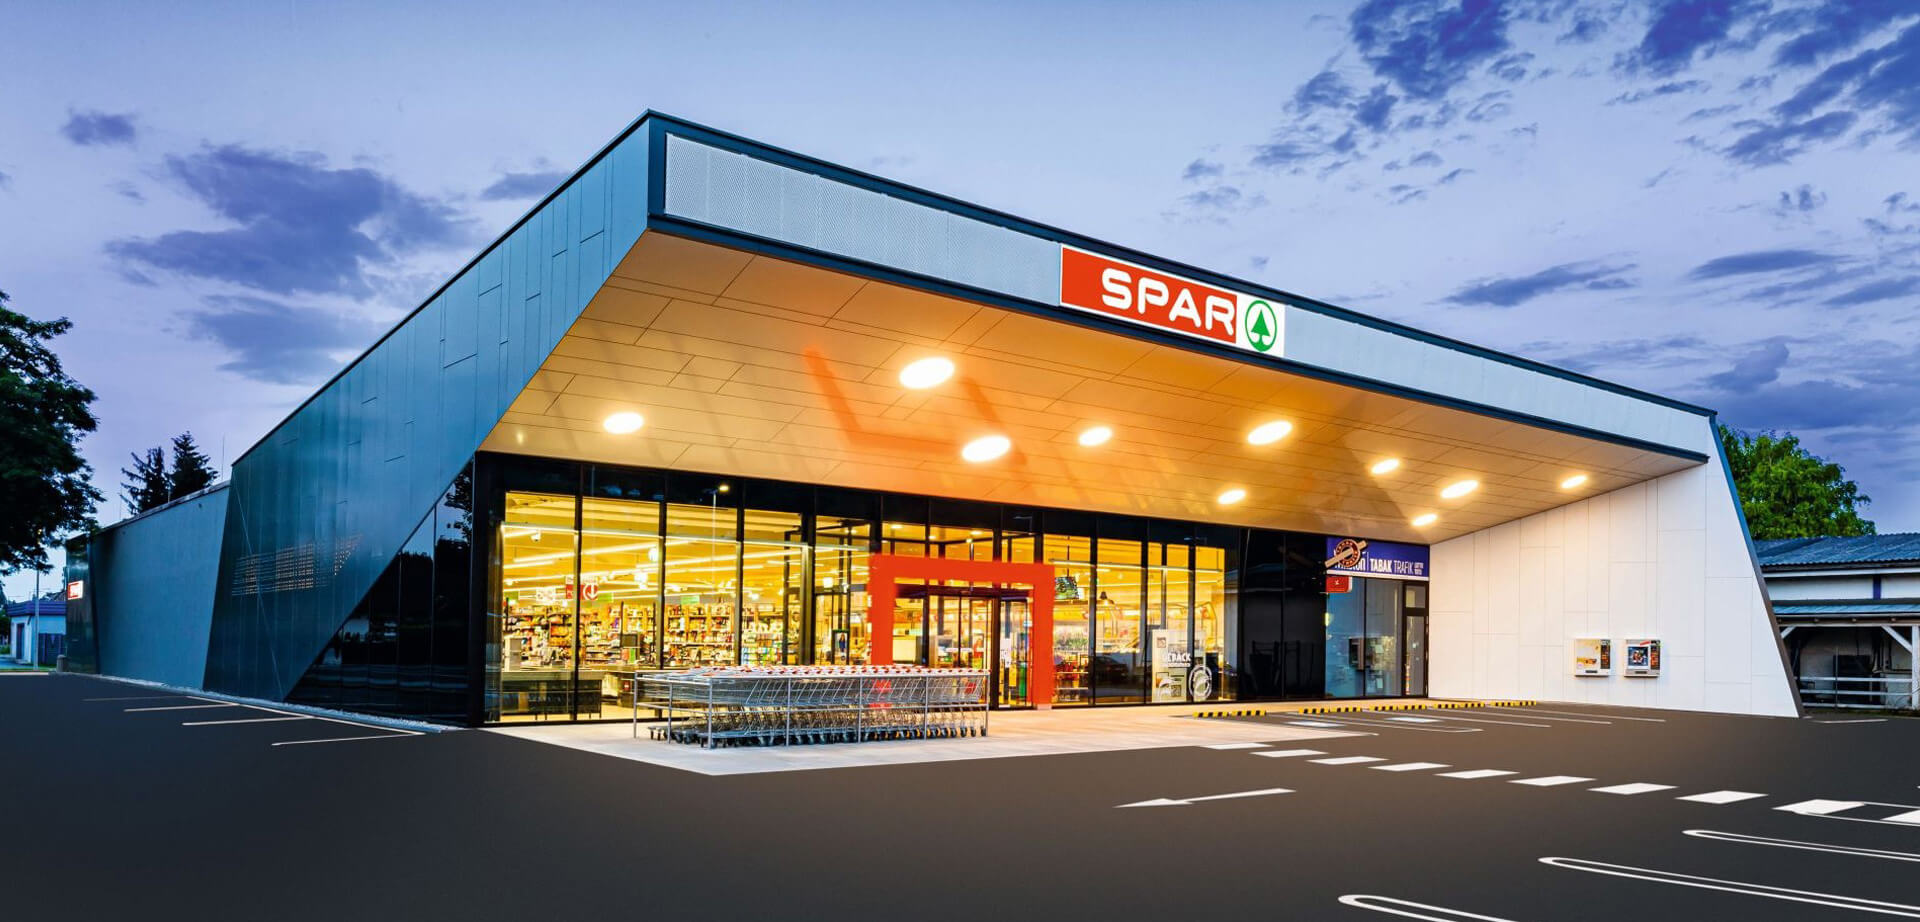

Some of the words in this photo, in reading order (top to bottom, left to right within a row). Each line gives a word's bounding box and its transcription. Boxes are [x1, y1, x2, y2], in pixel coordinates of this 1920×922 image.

[1101, 267, 1235, 336] SPAR
[1369, 558, 1393, 573] TABAK
[1393, 559, 1414, 575] TRAFIK
